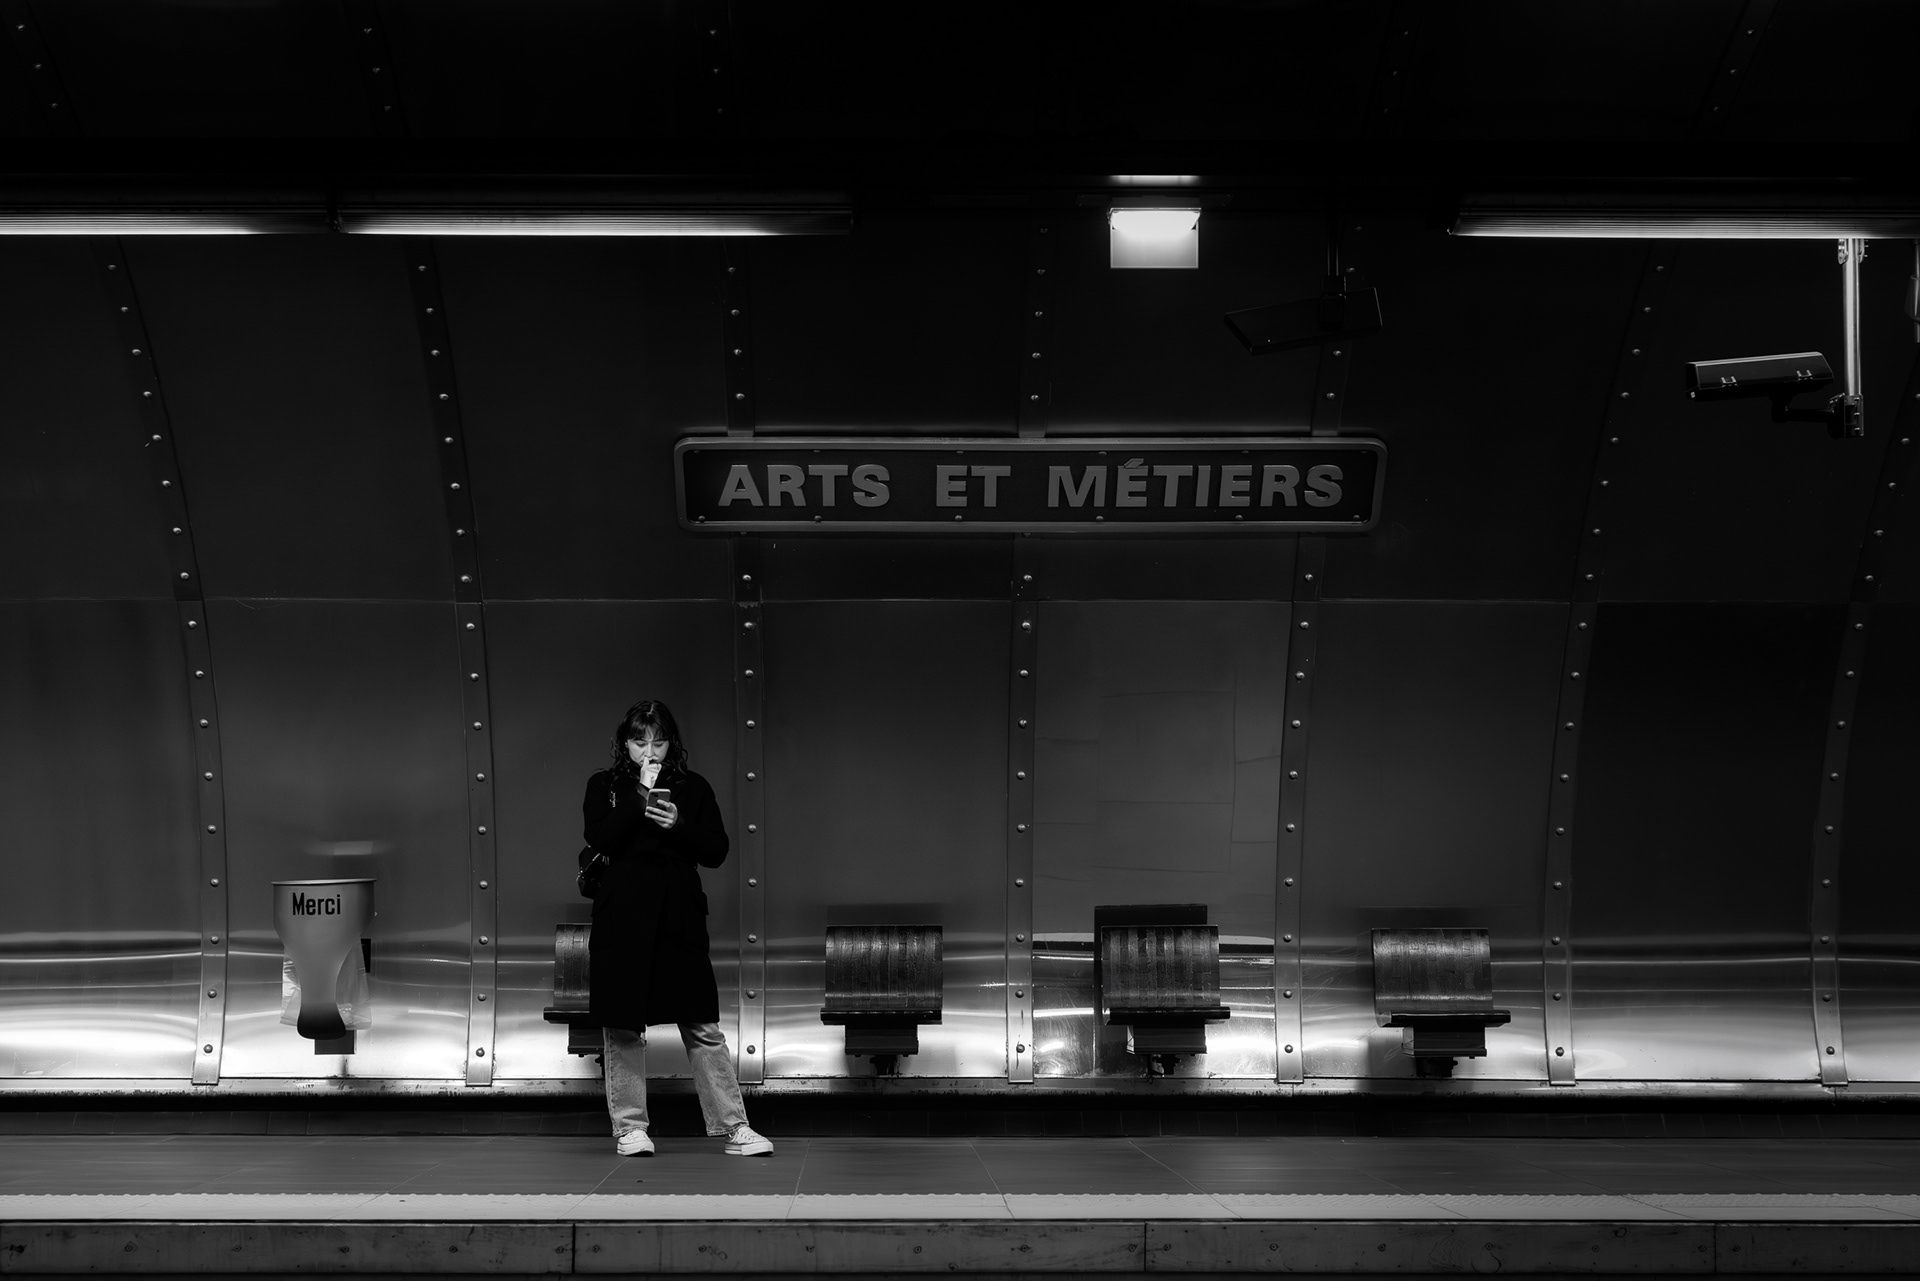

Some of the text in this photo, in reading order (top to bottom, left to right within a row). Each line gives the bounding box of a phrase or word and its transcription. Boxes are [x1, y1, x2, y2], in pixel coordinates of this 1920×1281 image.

[718, 458, 1344, 508] ARTS ET MÉTIERS
[292, 892, 341, 916] Merci
